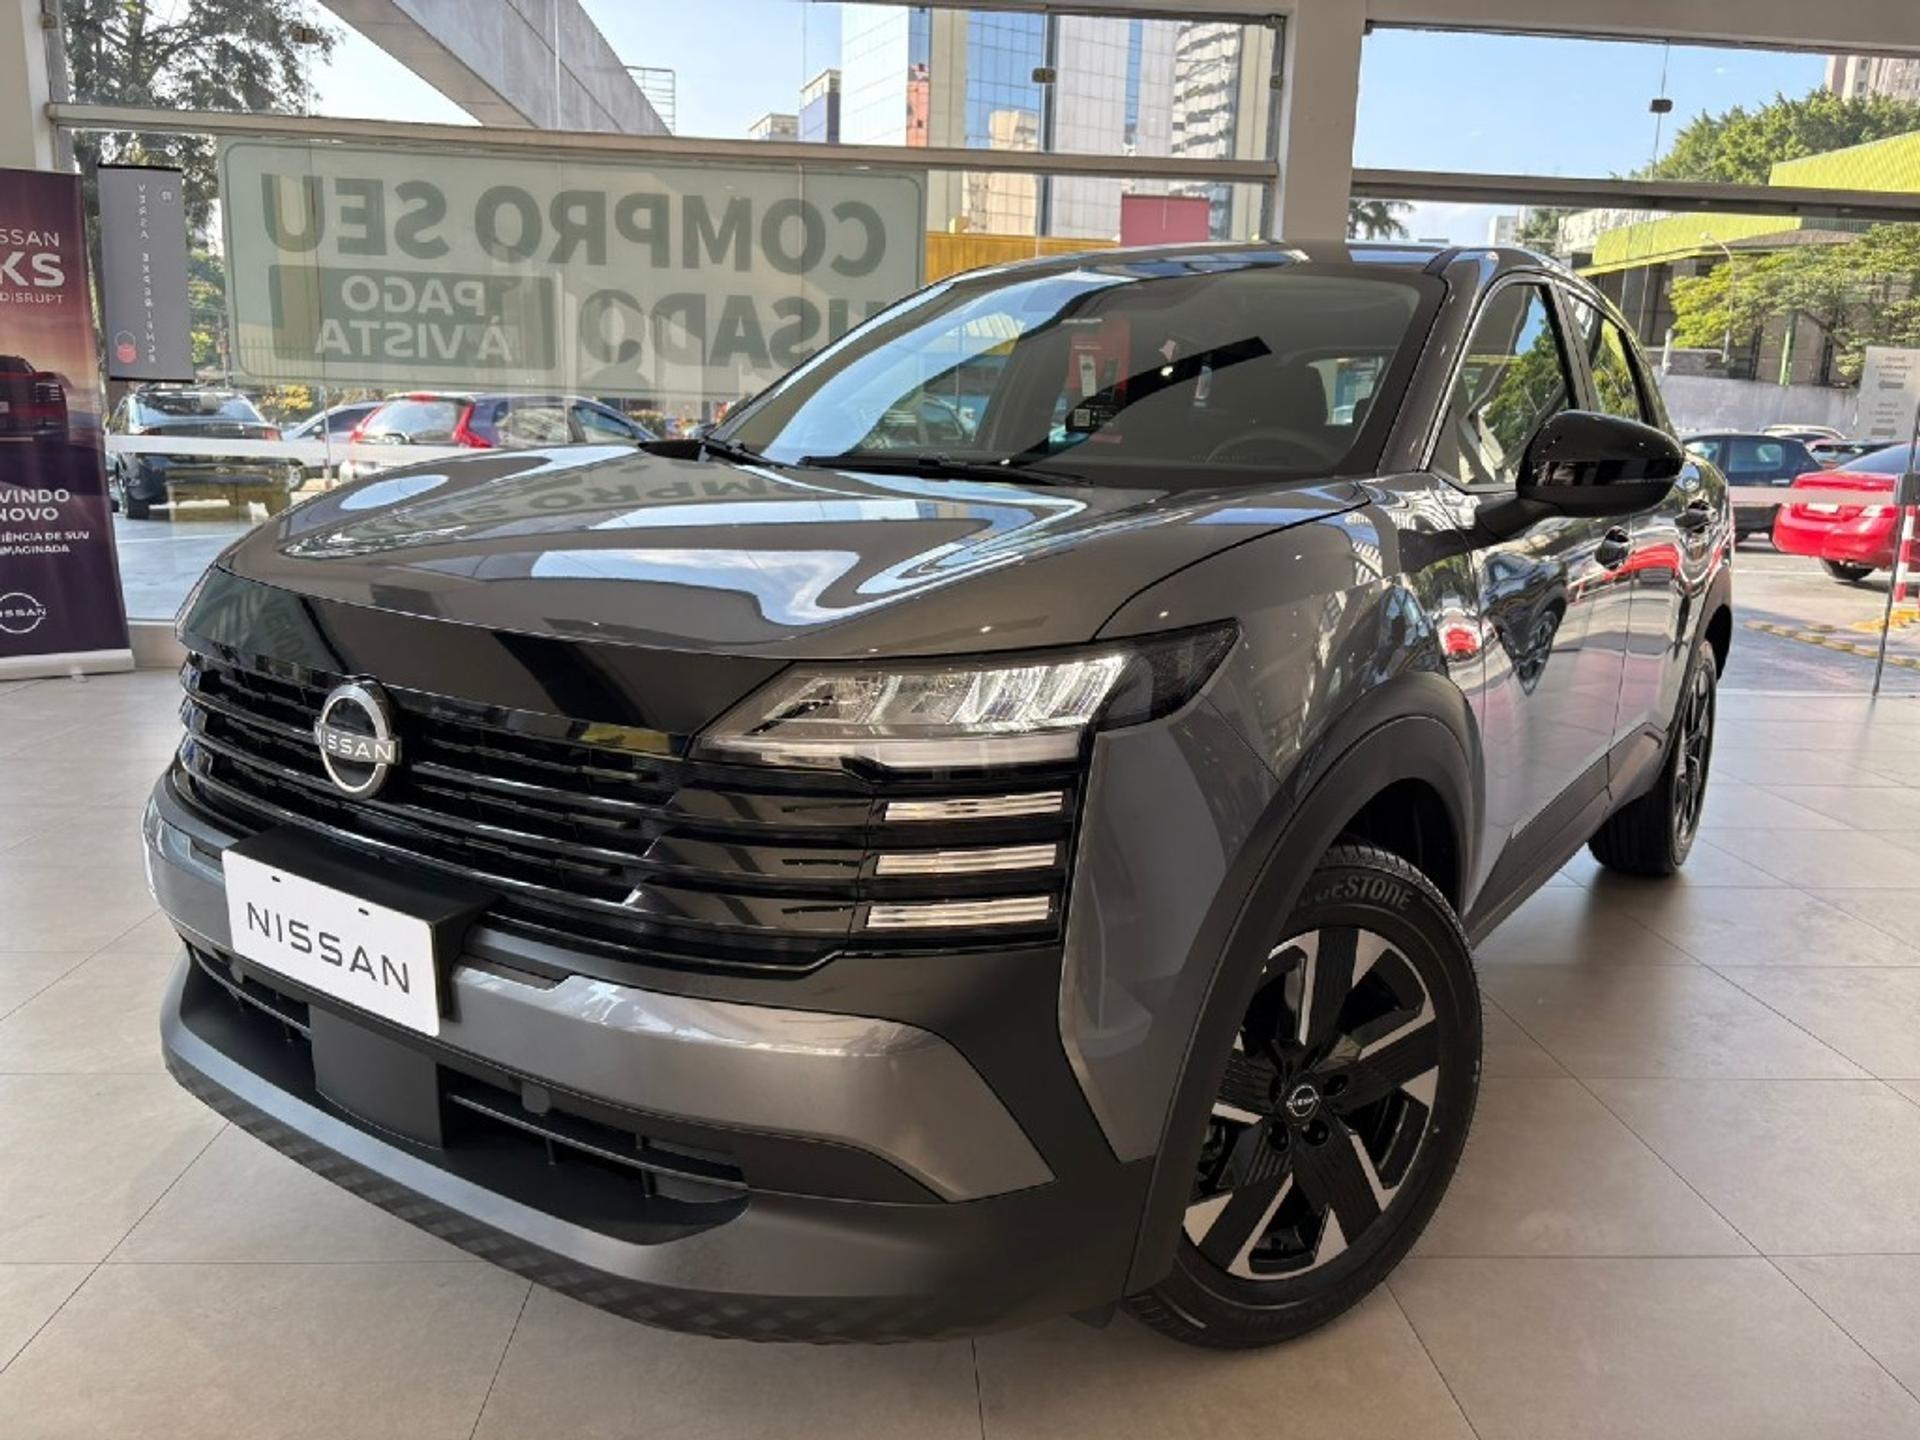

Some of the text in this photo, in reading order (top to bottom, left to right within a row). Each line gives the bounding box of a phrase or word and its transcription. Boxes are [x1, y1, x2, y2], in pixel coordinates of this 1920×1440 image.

[0, 228, 60, 248] SSAN
[0, 251, 65, 287] KS
[0, 292, 64, 304] DISRUPT
[0, 488, 70, 503] VINDO
[1, 531, 90, 543] IÊNCIA DE SUV
[0, 608, 47, 618] ISSAN
[314, 723, 393, 761] NISSAN
[246, 901, 411, 994] NISSAN
